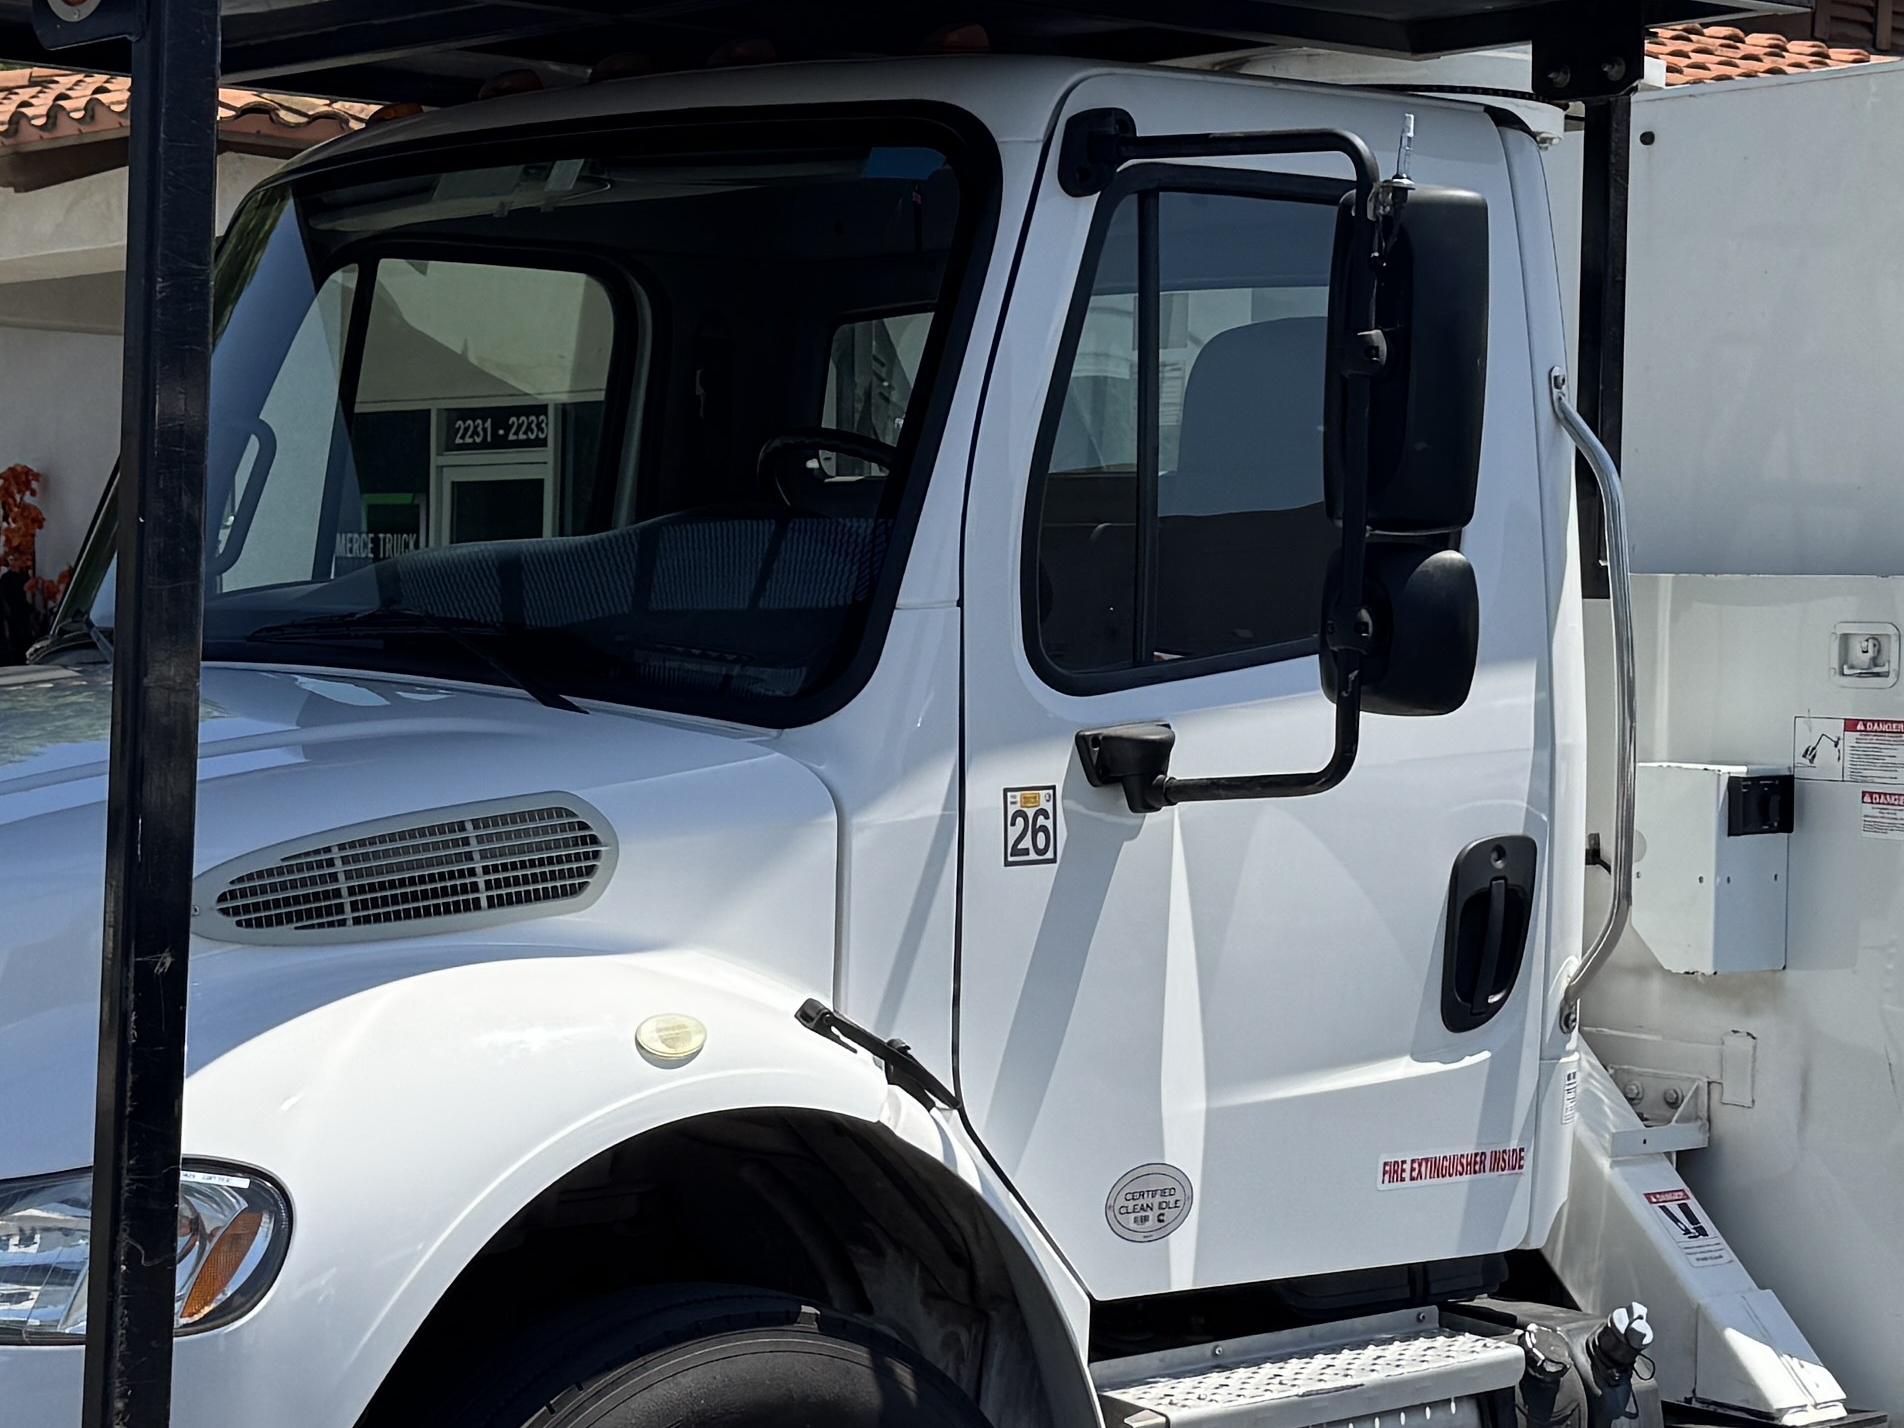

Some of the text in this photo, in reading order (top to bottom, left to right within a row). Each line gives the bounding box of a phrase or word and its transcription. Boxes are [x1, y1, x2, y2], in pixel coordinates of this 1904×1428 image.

[454, 418, 492, 444] 2231
[508, 415, 548, 441] 2233
[378, 532, 417, 559] TRUCK
[1866, 721, 1904, 733] DANGER
[1010, 807, 1051, 858] 26
[1382, 1147, 1525, 1184] FIRE EXTINGUISHER INSIDE
[1118, 1200, 1181, 1216] CLEAN IDLE
[1124, 1187, 1176, 1202] CERTIFIED
